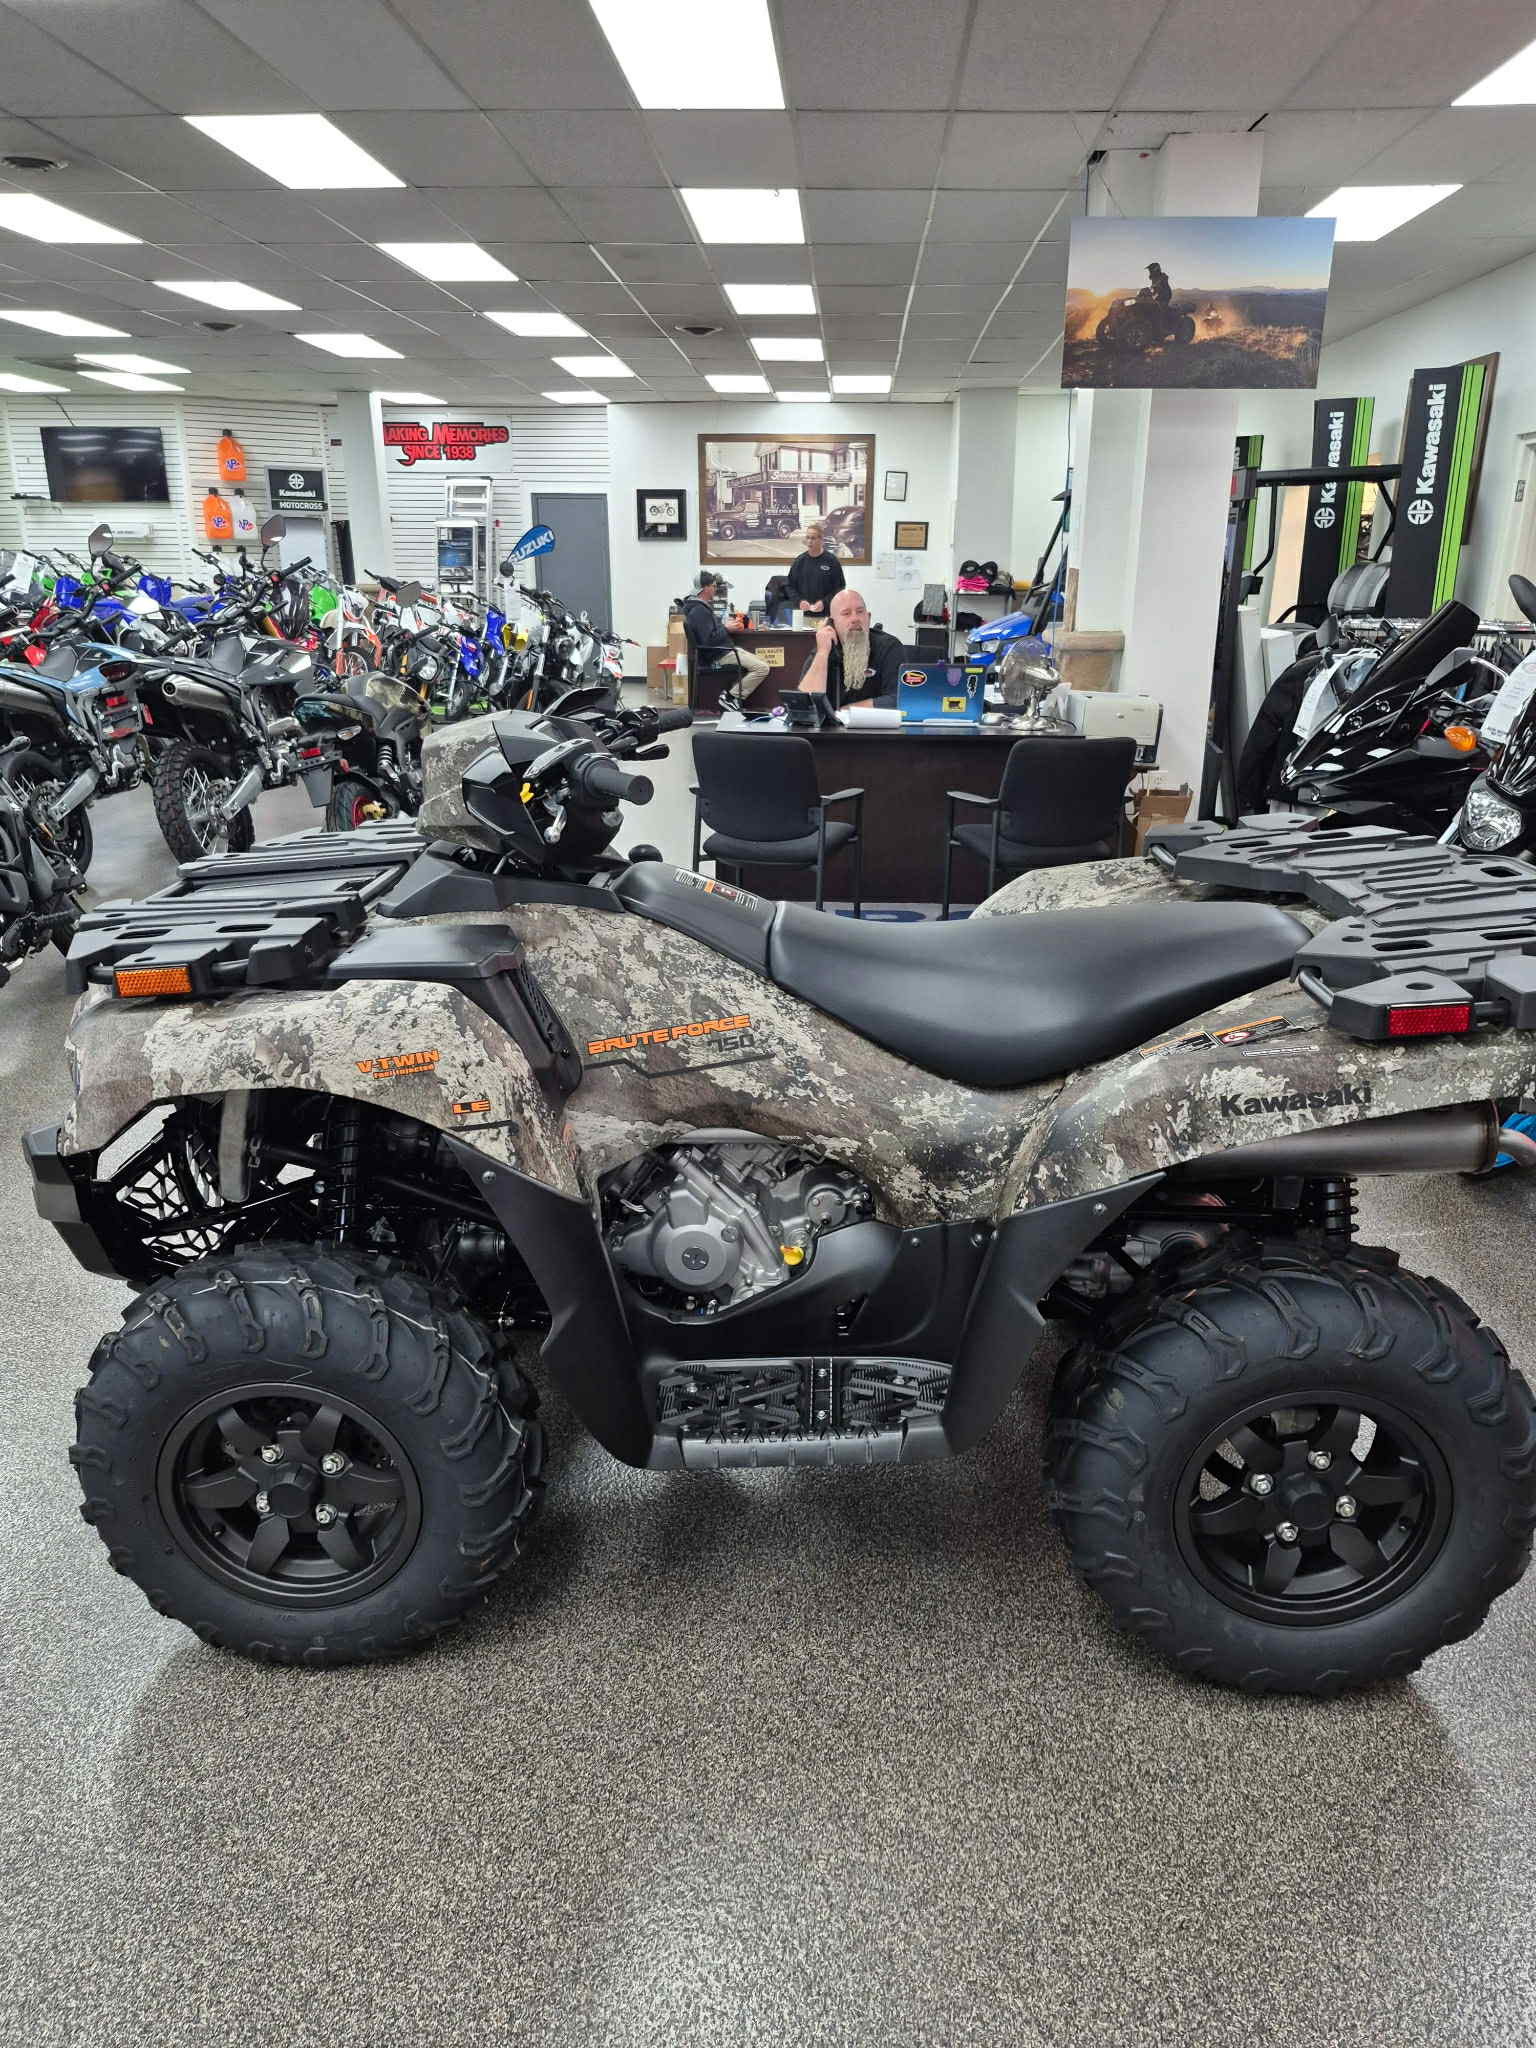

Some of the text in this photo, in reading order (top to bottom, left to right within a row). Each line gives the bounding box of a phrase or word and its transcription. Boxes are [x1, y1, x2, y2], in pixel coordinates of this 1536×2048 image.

[383, 422, 509, 445] AKING MEMORIES
[1415, 383, 1447, 495] Kawasaki
[396, 445, 477, 466] SINCE 1938
[279, 501, 324, 510] MOTOCROSS
[587, 1014, 752, 1056] BRUTE FORCE
[709, 1033, 756, 1053] 750
[355, 1048, 441, 1073] V-TWIN
[451, 1100, 492, 1115] LE
[1220, 1079, 1372, 1118] Kawasaki
